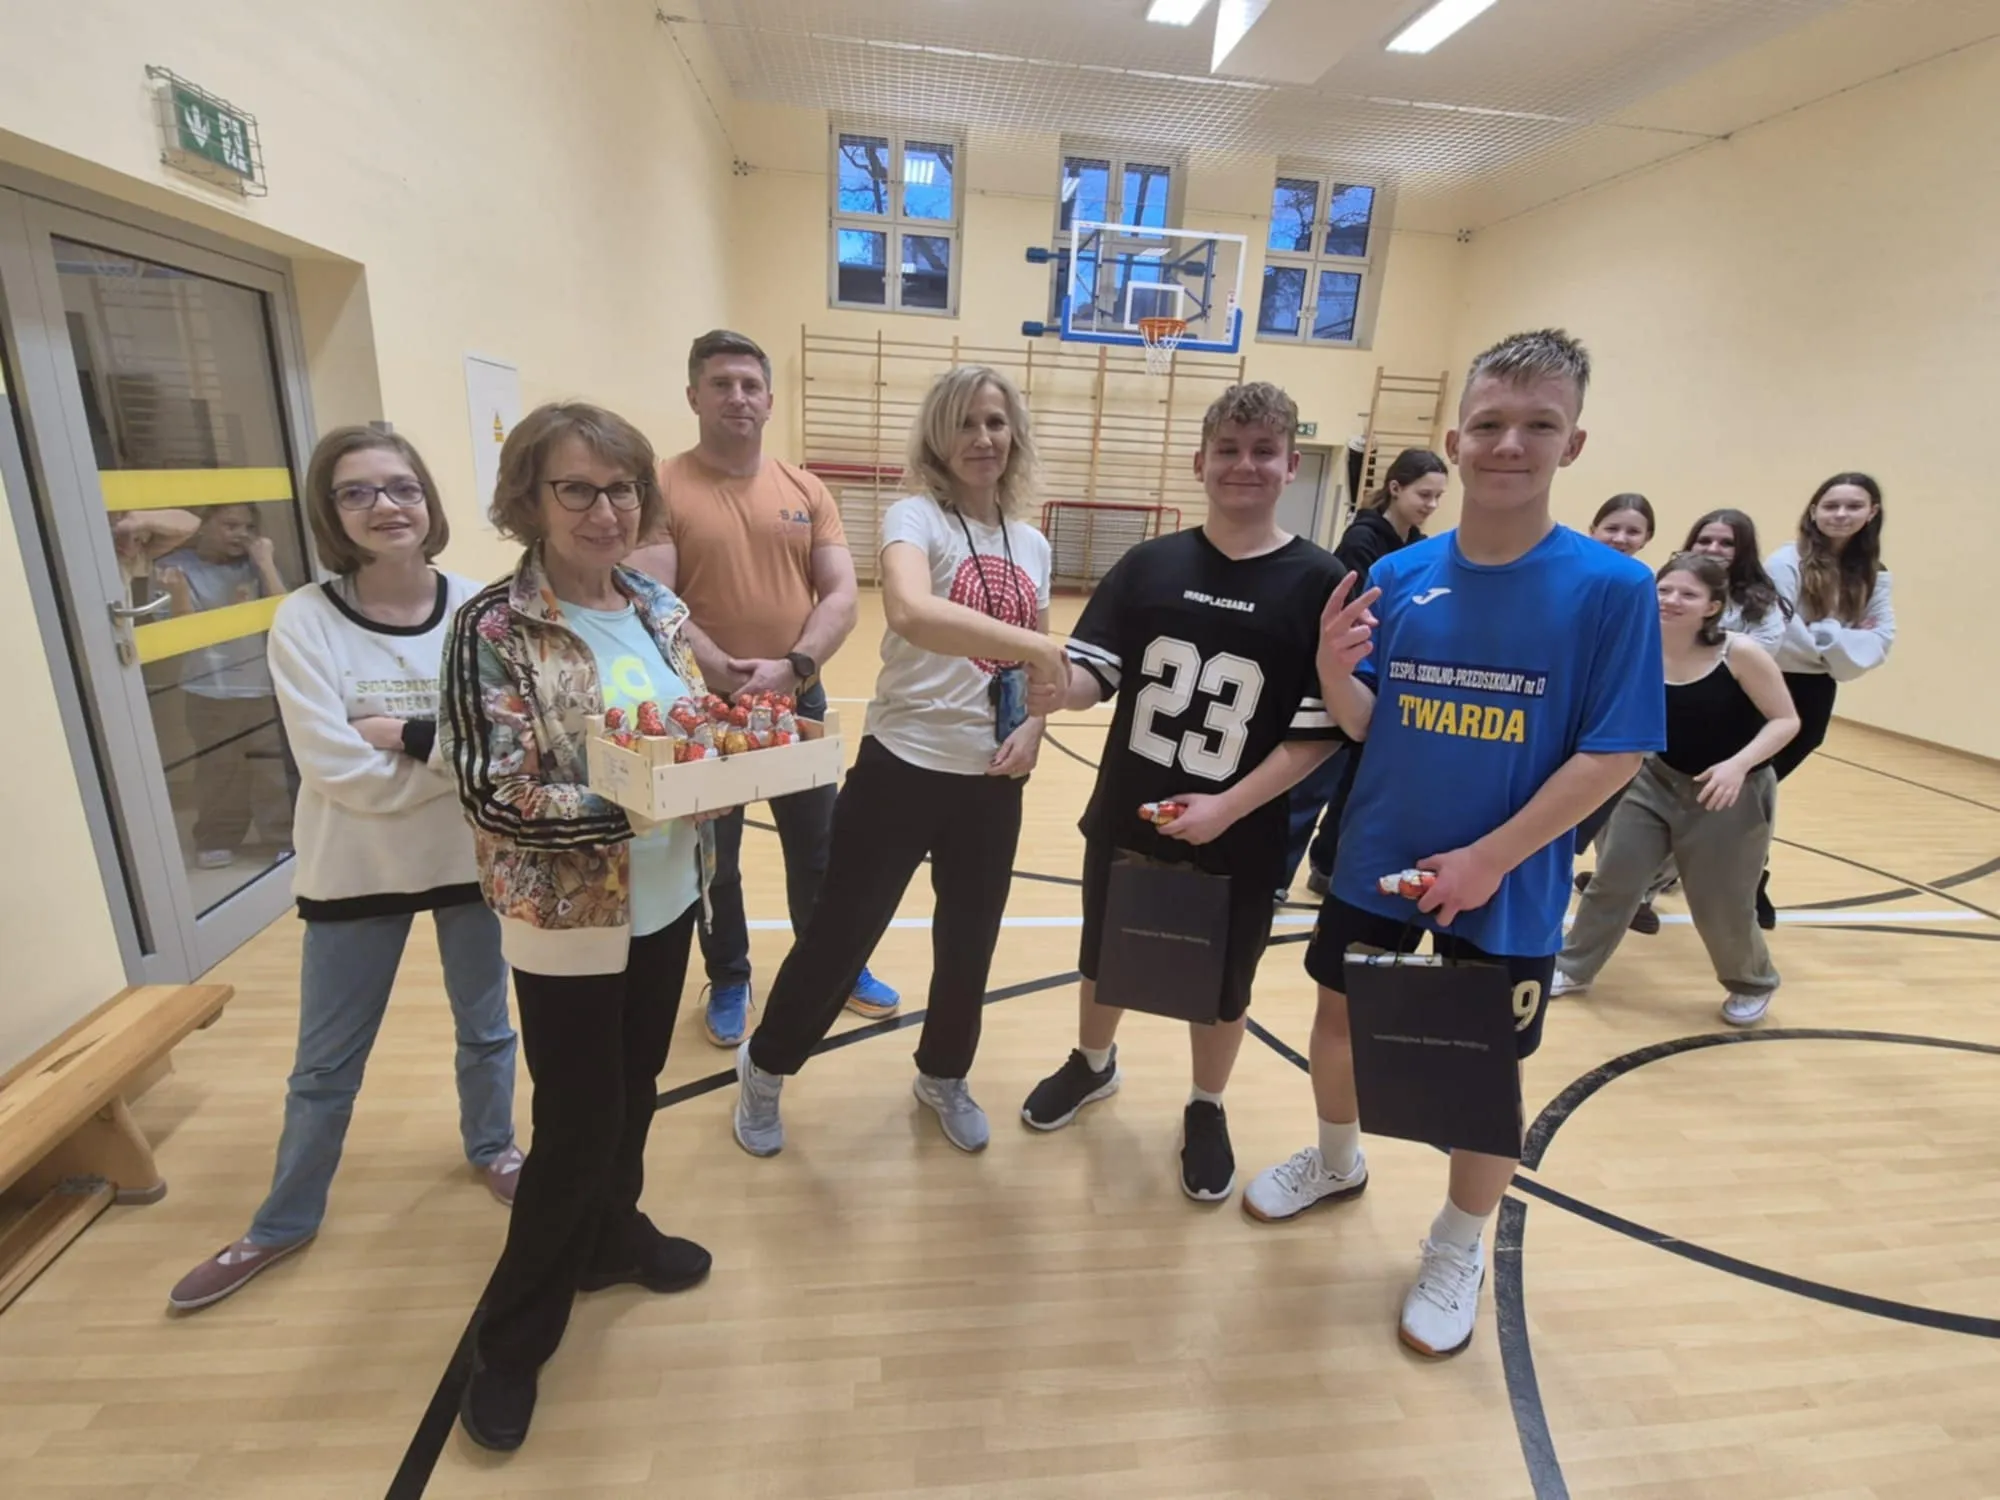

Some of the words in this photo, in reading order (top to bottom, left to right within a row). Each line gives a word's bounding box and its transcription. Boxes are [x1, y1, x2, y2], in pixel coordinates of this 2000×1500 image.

[1183, 590, 1256, 613] IRREPLACEABLE
[1523, 683, 1536, 695] nr
[1535, 676, 1548, 696] 13
[1128, 635, 1265, 782] 23
[1398, 694, 1526, 744] TWARDA
